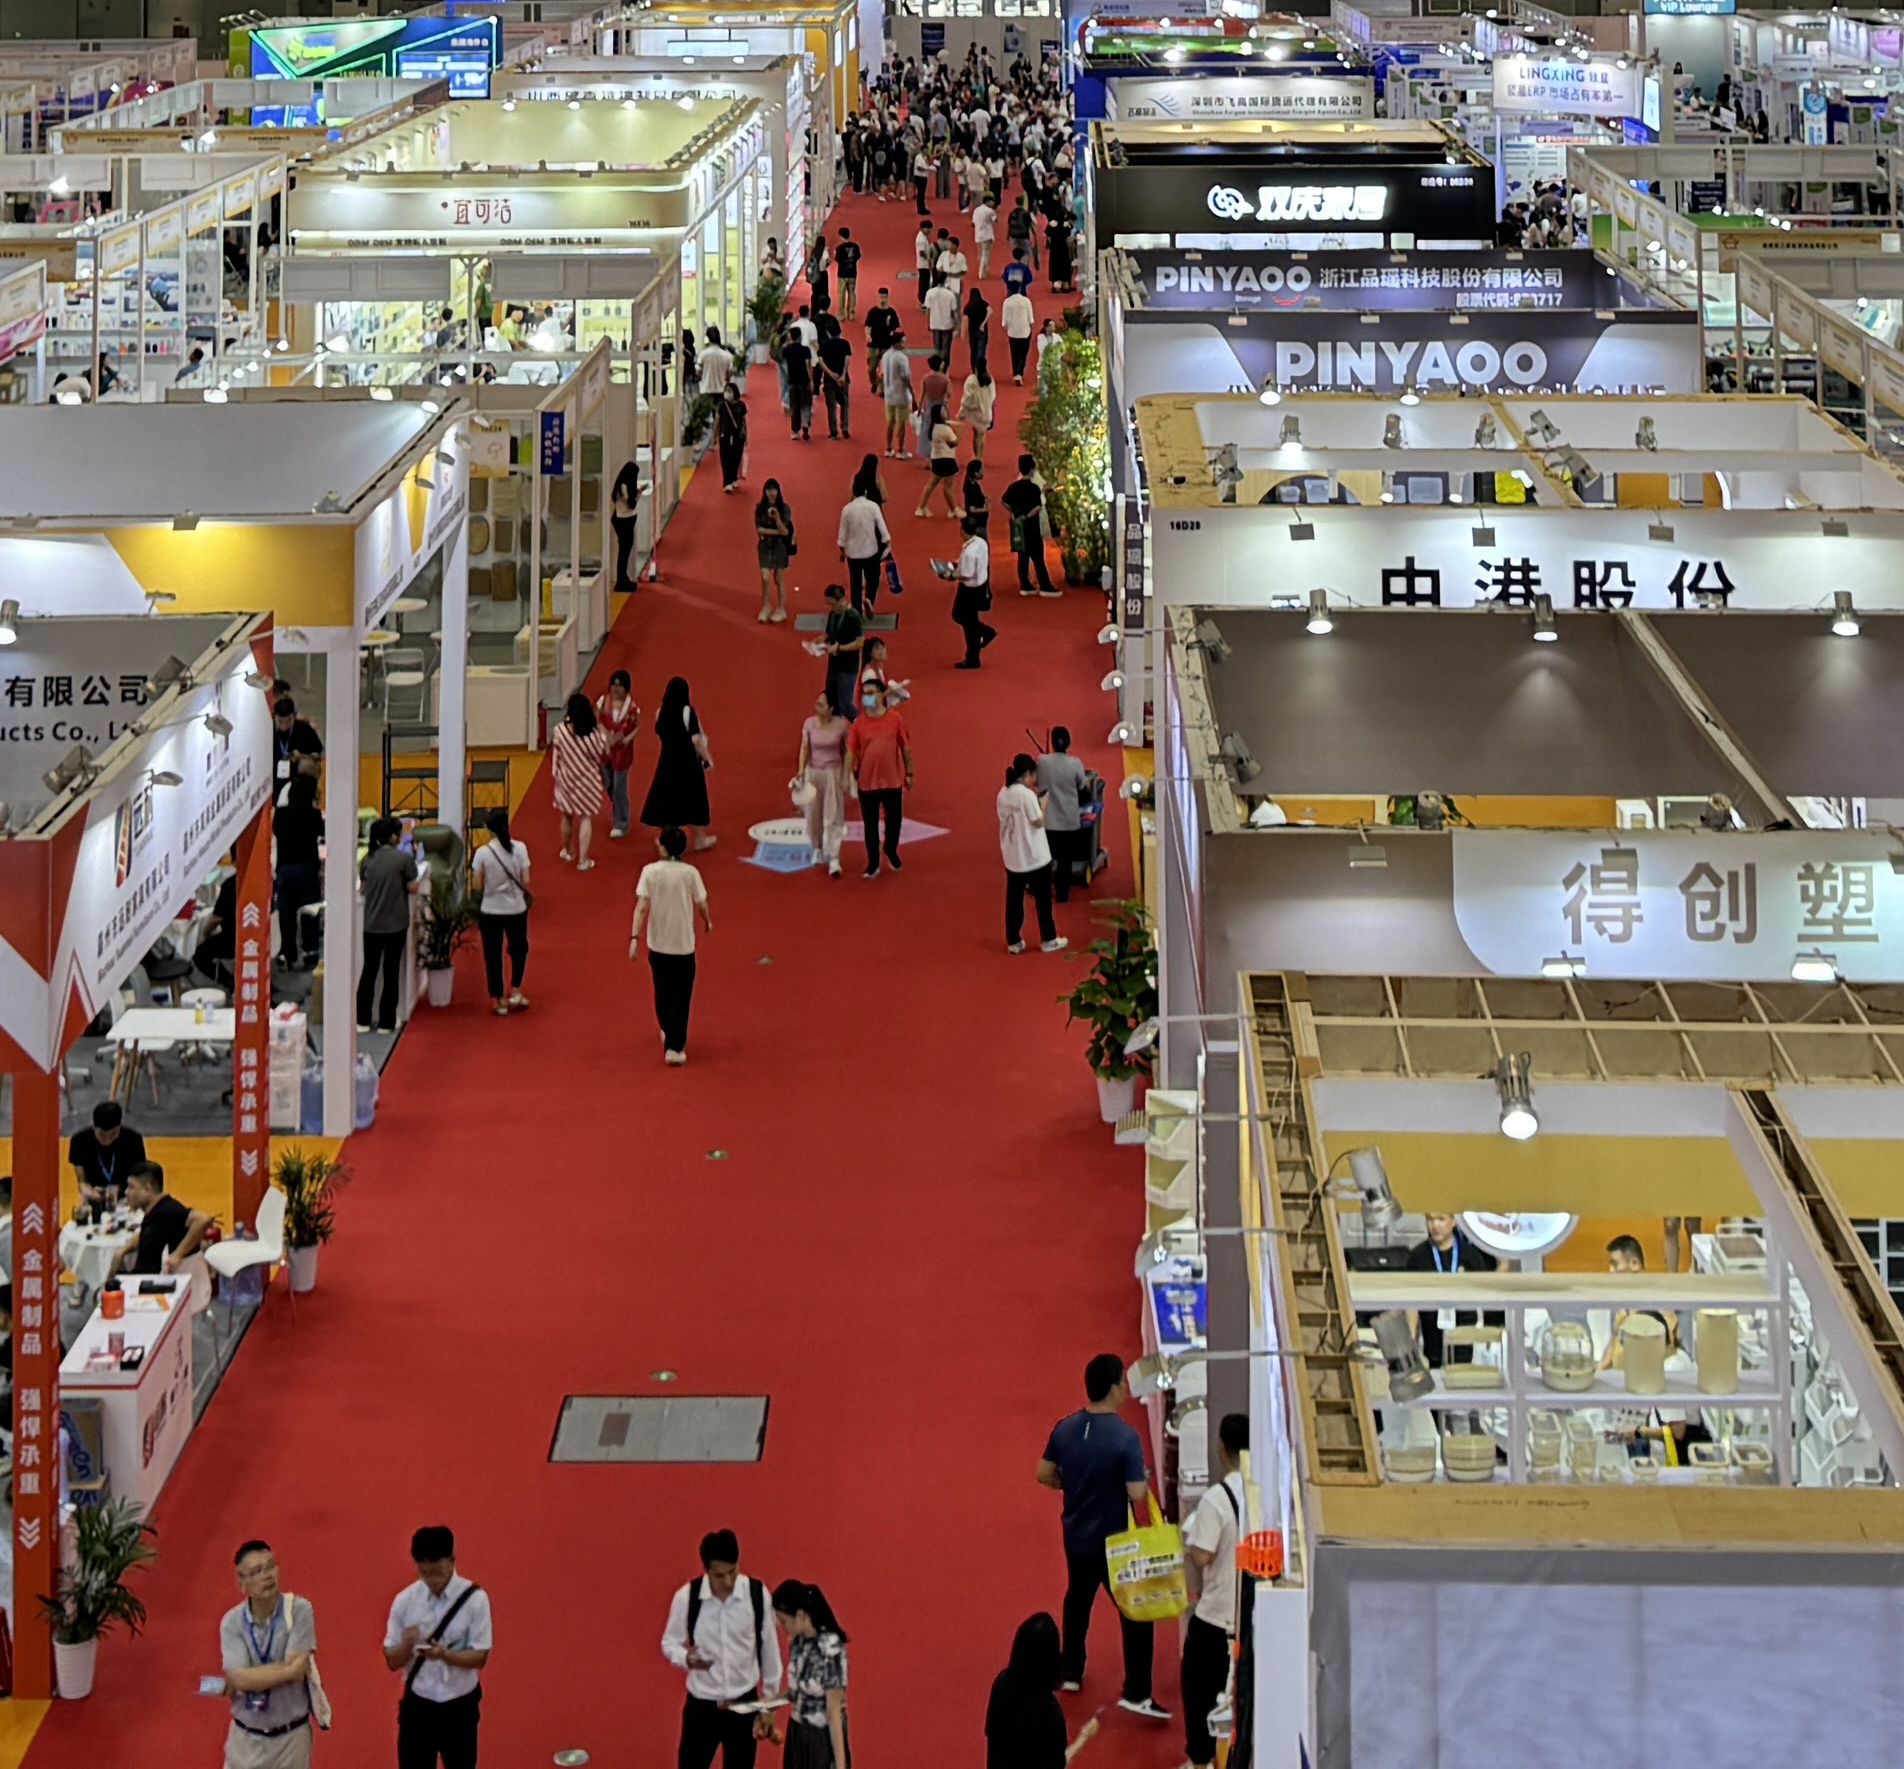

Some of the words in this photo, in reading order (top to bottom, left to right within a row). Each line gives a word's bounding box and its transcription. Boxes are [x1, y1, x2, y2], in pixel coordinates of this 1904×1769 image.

[1519, 66, 1585, 83] LINGXING
[1155, 265, 1312, 294] PINYAOO
[1318, 268, 1563, 290] 浙江品瑶科技股份有限公司
[1275, 340, 1548, 387] PINYAOO
[52, 719, 100, 743] Co.,
[21, 1247, 44, 1357] 金属制品
[18, 1386, 43, 1496] 强悍承重
